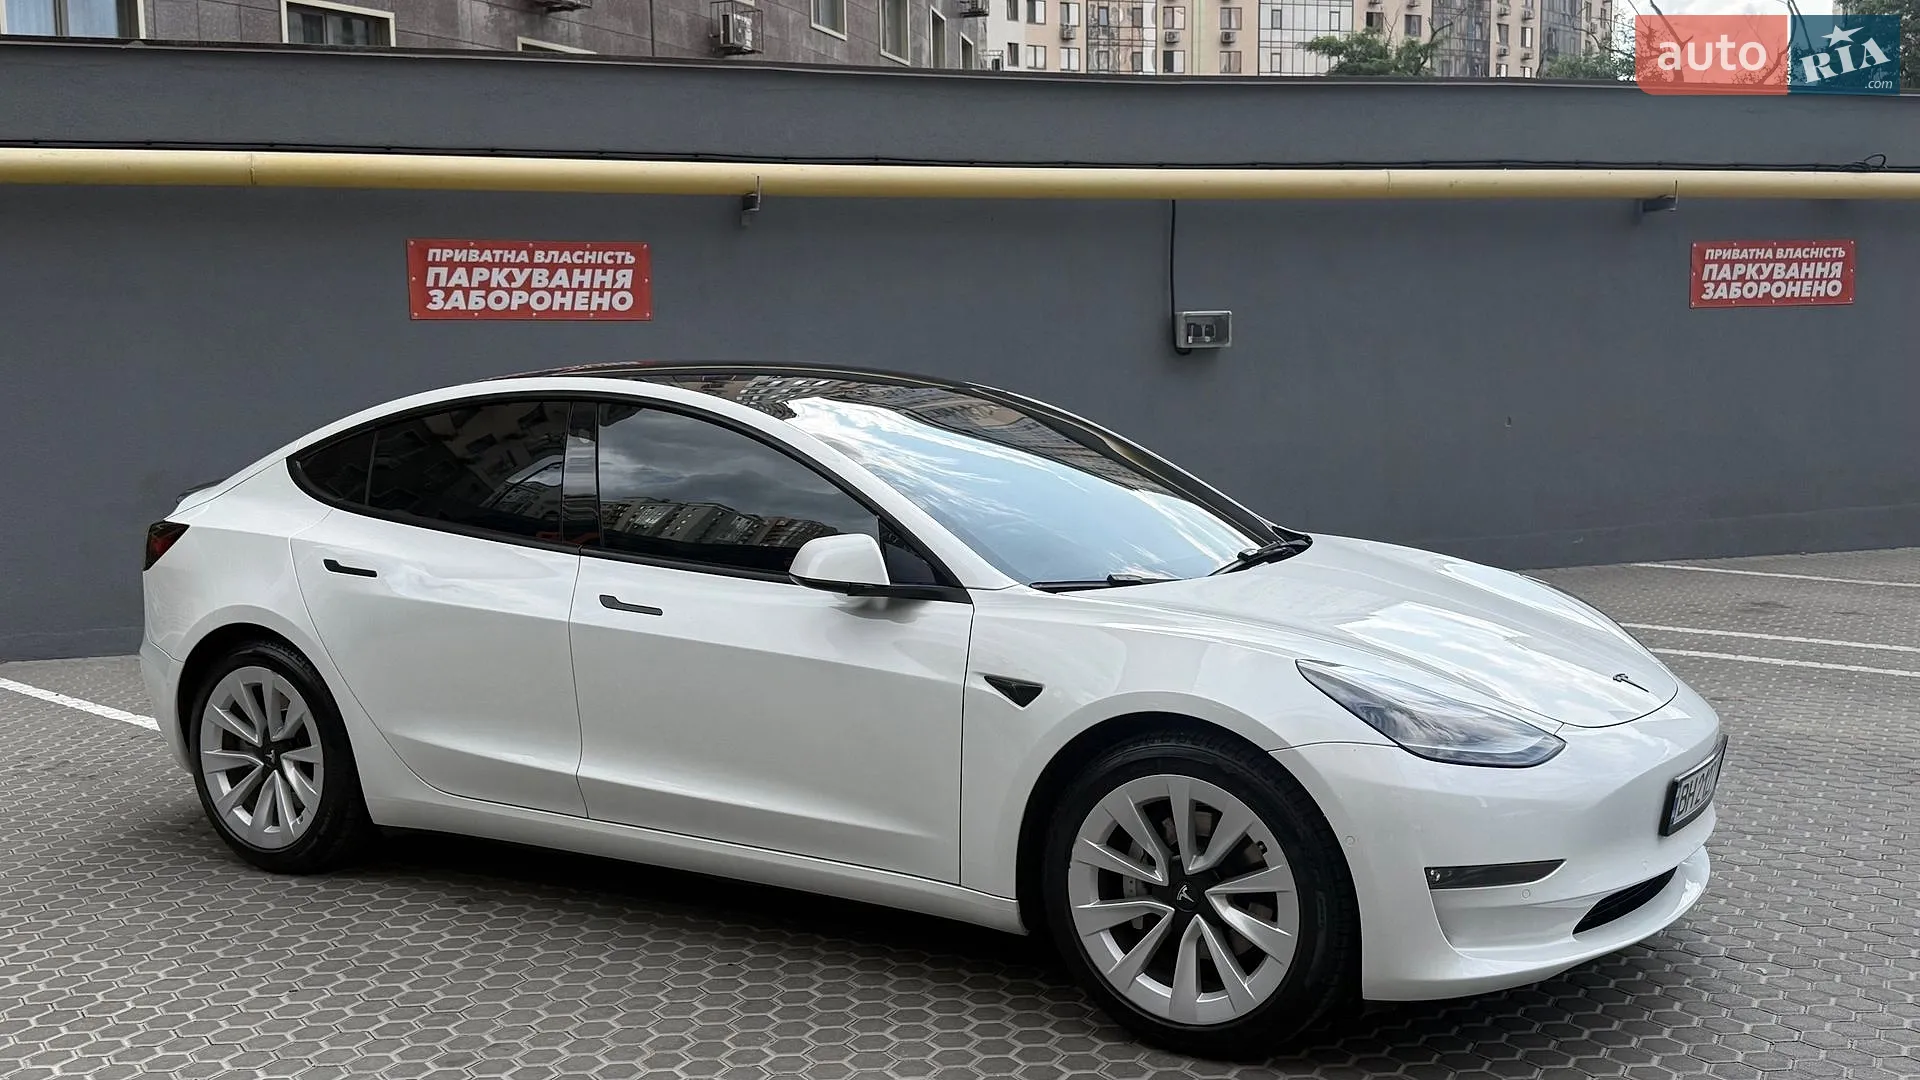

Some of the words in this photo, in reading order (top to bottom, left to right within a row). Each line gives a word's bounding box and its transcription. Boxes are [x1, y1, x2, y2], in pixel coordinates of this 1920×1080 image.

[427, 249, 529, 263] ПРИВАТНА
[533, 250, 636, 264] ВЛАСНІСТЬ
[1705, 248, 1773, 260] ПРИВАТНА
[1775, 247, 1846, 259] ВЛАСНІСТЬ
[426, 267, 634, 289] ПАРКУВАННЯ
[1702, 261, 1843, 280] ПАРКУВАННЯ
[1701, 280, 1842, 299] ЗАБОРОНЕНО
[426, 290, 634, 311] ЗАБОРОНЕНО
